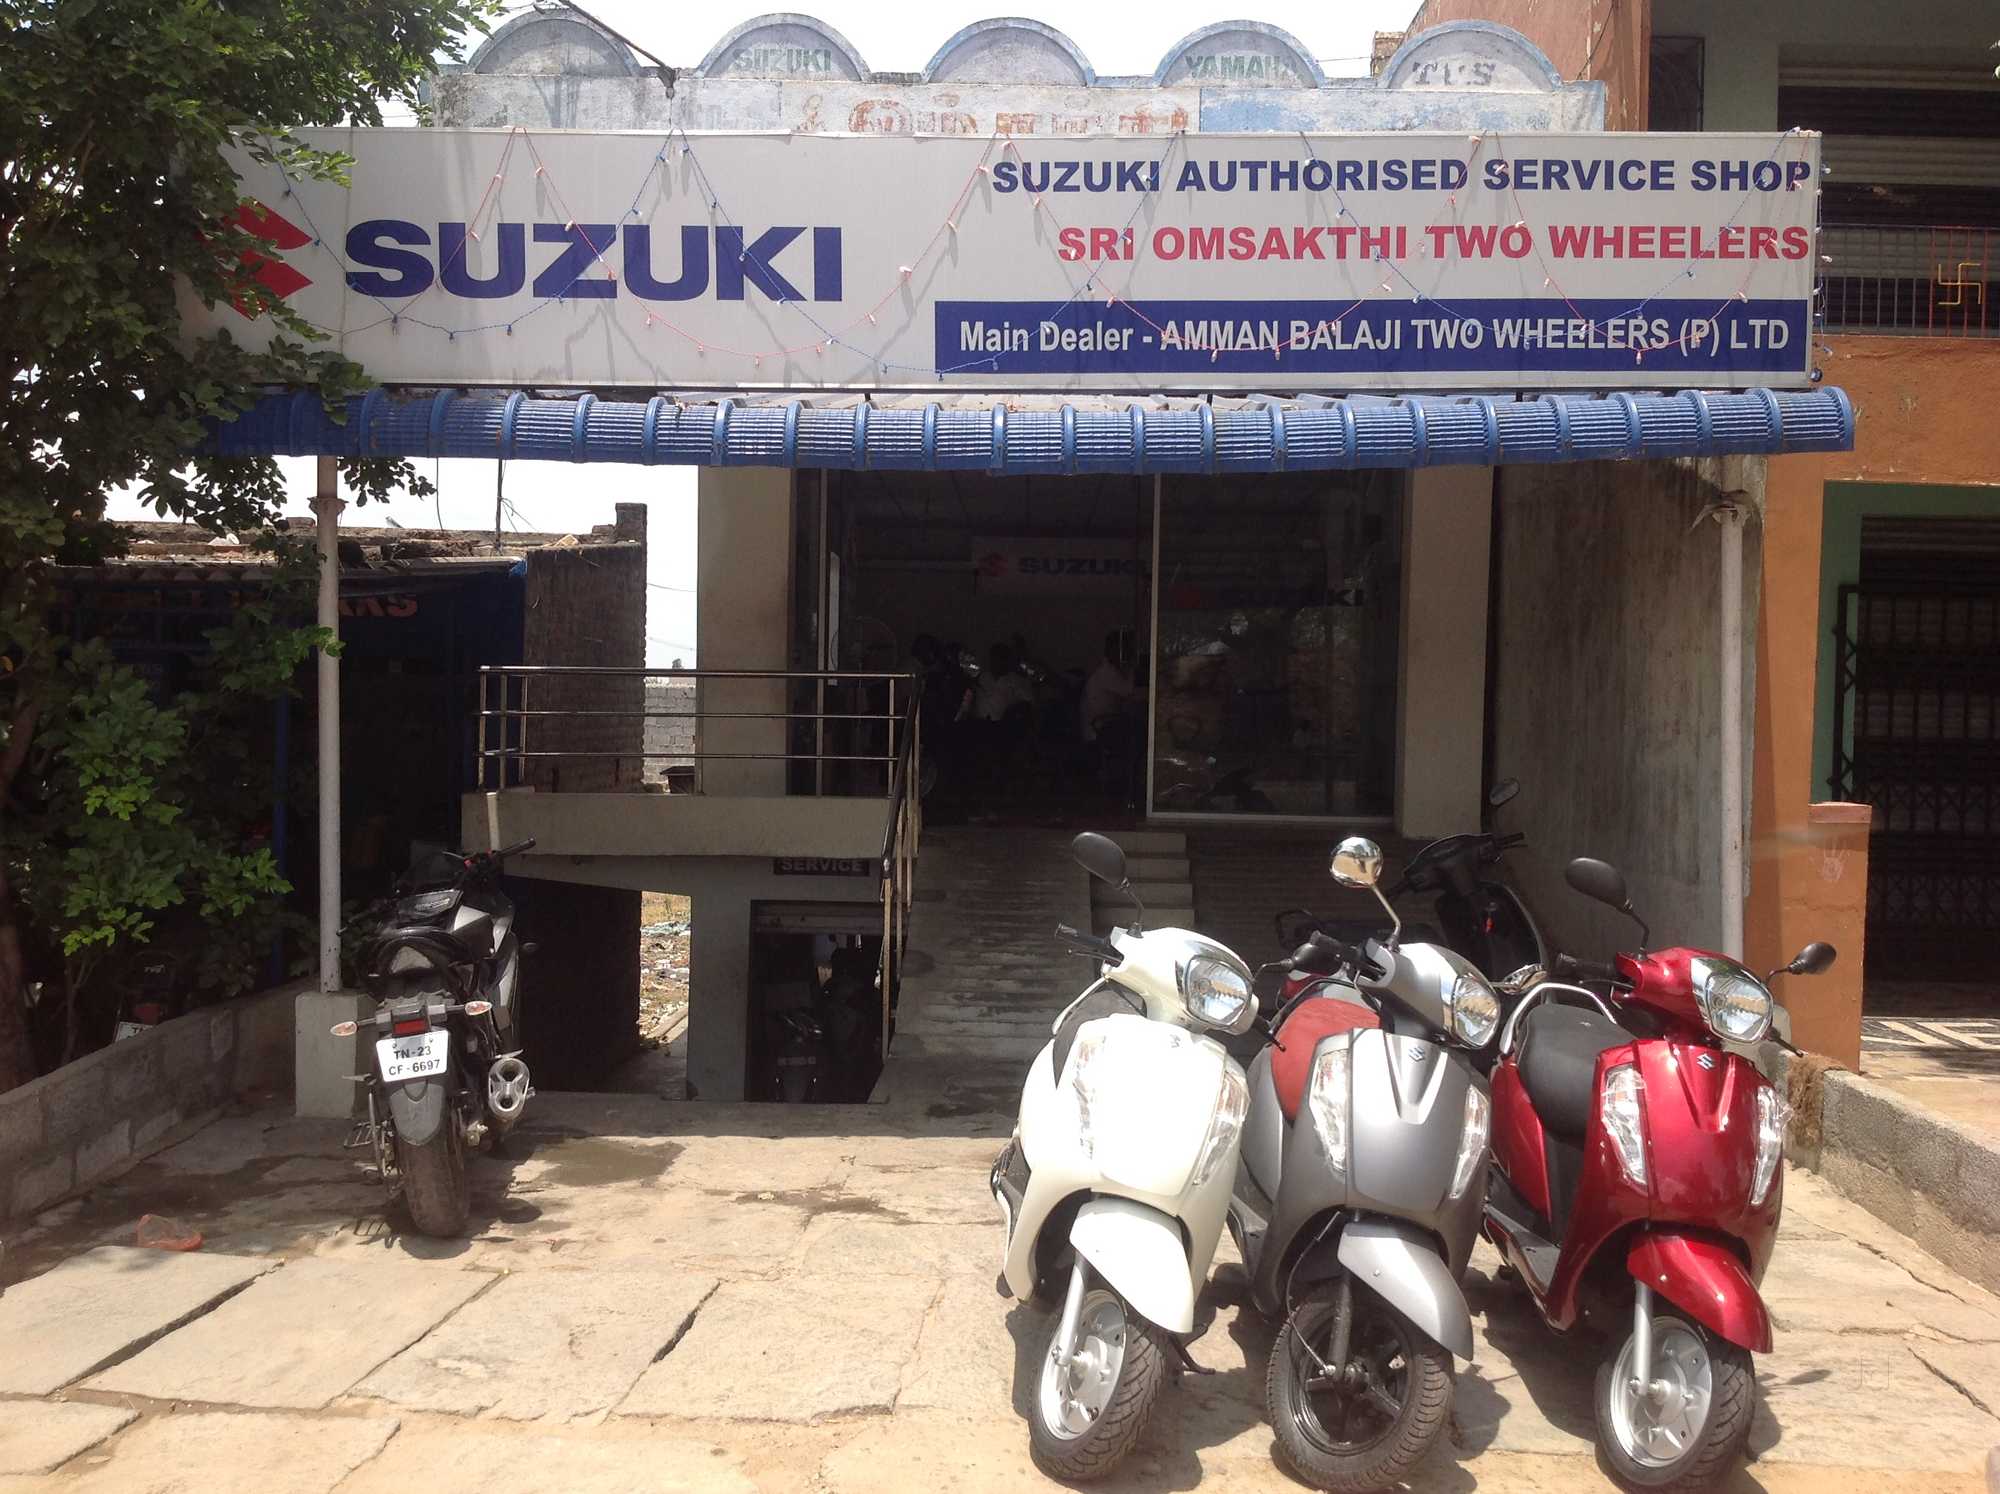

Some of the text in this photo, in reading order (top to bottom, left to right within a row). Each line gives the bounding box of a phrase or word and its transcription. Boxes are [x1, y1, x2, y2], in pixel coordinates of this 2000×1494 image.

[992, 158, 1811, 193] SUZUKI AUTHORISED SERVICE SHOP
[1057, 225, 1809, 261] SRI OMSAKTHI TWO WHEELERS
[345, 219, 842, 304] SUZUKI
[959, 320, 1030, 352] Main
[1040, 320, 1135, 352] Dealer
[1159, 319, 1280, 351] AMMAN
[1290, 319, 1402, 351] BALAJI
[1410, 319, 1483, 350] TWO
[1492, 318, 1670, 350] WHEELERS
[1679, 317, 1720, 357] (P)
[1730, 319, 1789, 350] LTD
[781, 858, 863, 873] SERVICE
